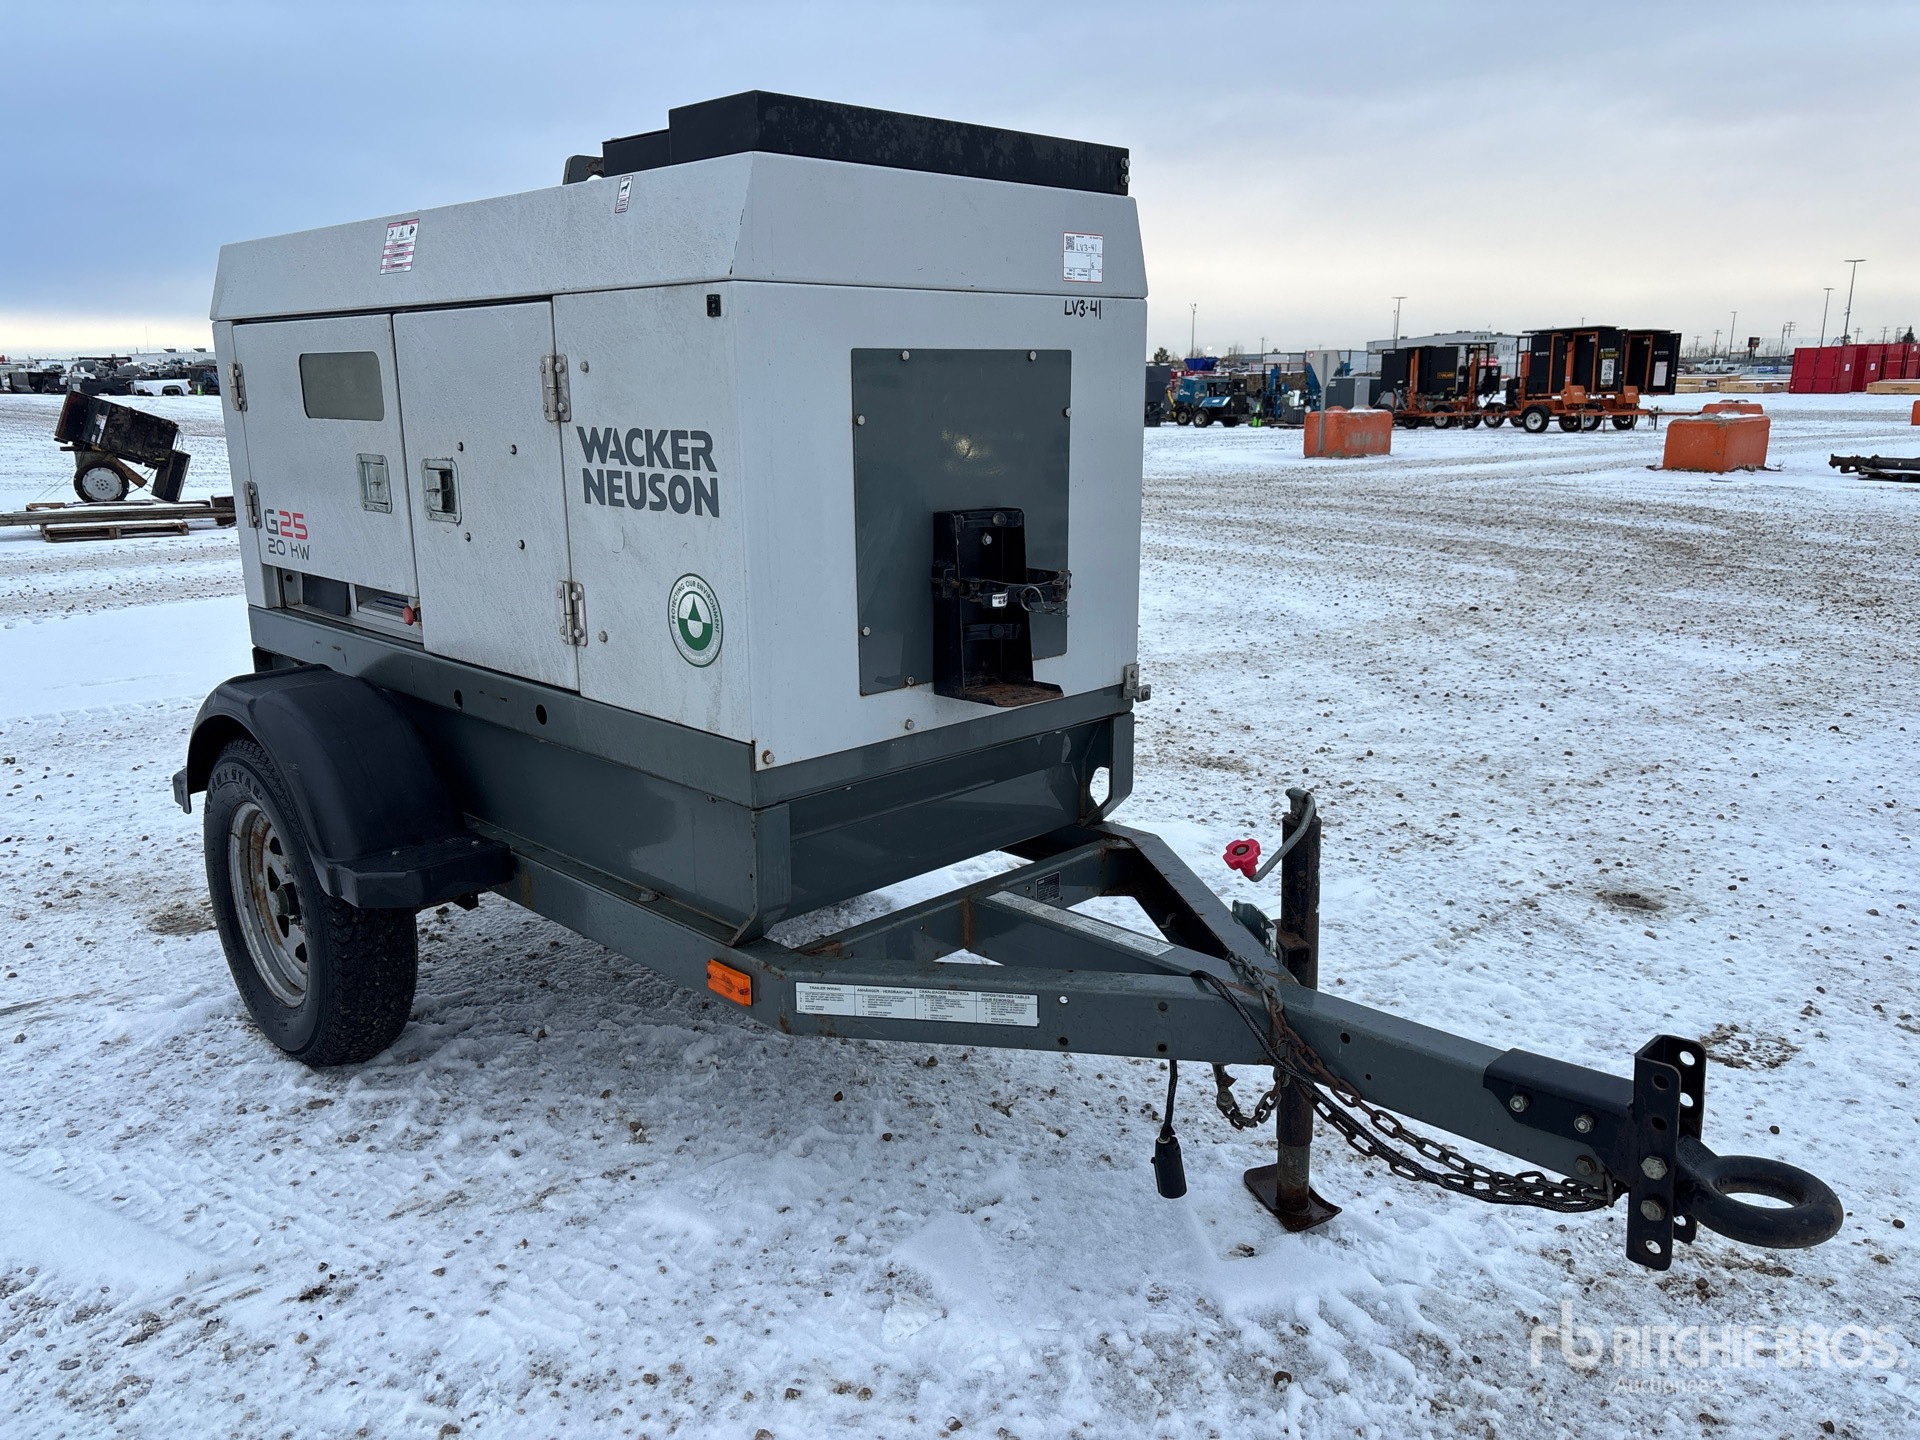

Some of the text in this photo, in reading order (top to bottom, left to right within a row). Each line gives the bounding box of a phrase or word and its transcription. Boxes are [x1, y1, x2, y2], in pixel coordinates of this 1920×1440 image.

[576, 426, 718, 472] WACKER
[582, 468, 720, 518] NEUSON
[264, 508, 308, 540] G25
[267, 537, 286, 556] 20
[671, 580, 720, 634] PROTECTING OUR ENVIRONMENT
